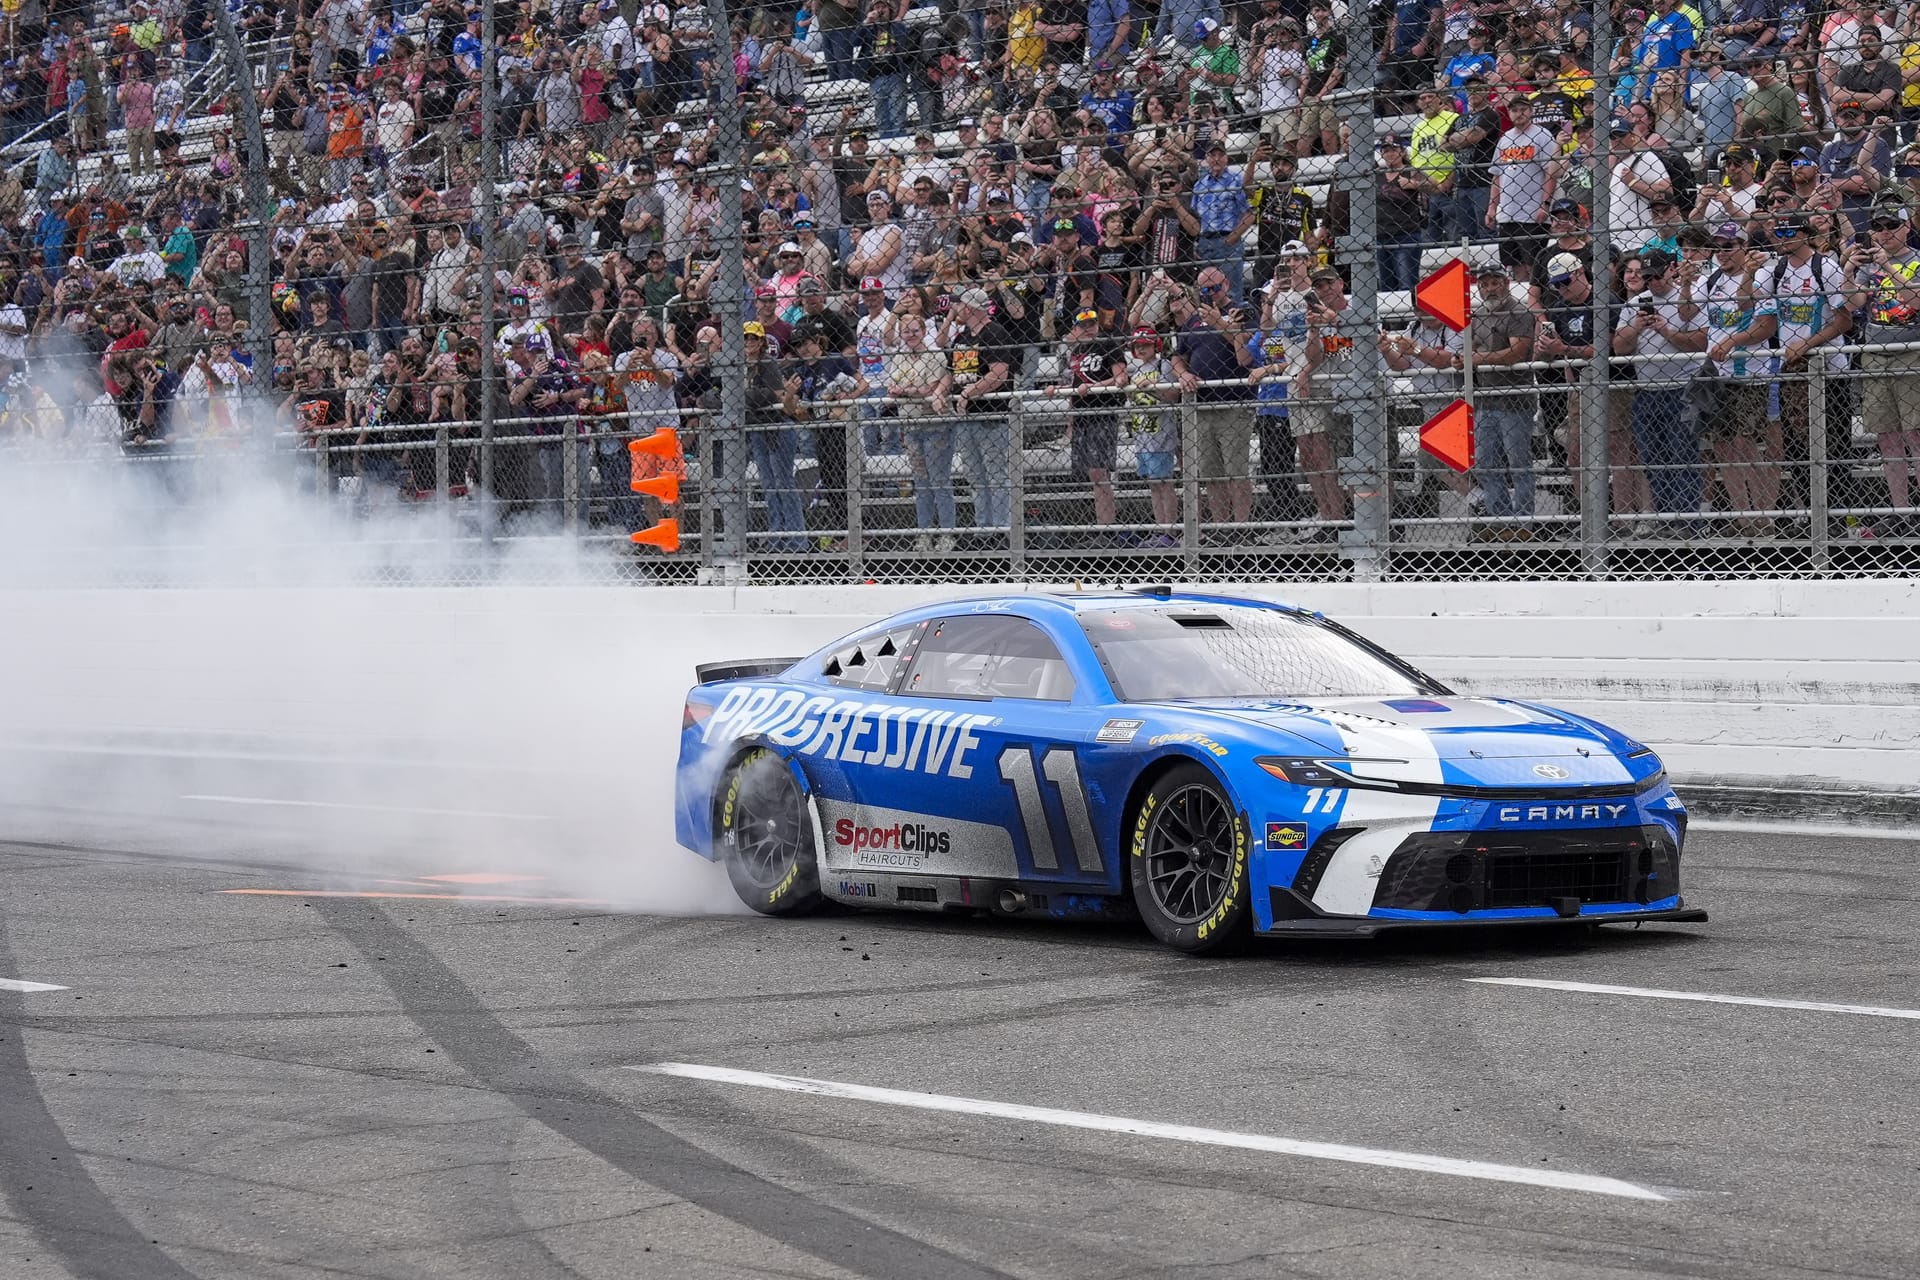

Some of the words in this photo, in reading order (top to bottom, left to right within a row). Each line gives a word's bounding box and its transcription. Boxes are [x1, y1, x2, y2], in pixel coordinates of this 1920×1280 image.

[1080, 353, 1103, 372] 20
[701, 686, 995, 780] PROGRESSIVE
[1148, 733, 1229, 757] GOODYEAR
[998, 748, 1105, 872] 11
[1302, 788, 1342, 814] 11
[1500, 804, 1627, 822] CAMRY
[1132, 793, 1157, 857] EAGLE
[1269, 832, 1305, 841] SUNOCO
[860, 853, 921, 867] HAIRCUTS
[840, 881, 866, 897] Mobil
[867, 883, 877, 897] 1
[1197, 817, 1245, 940] GOODYEAR
